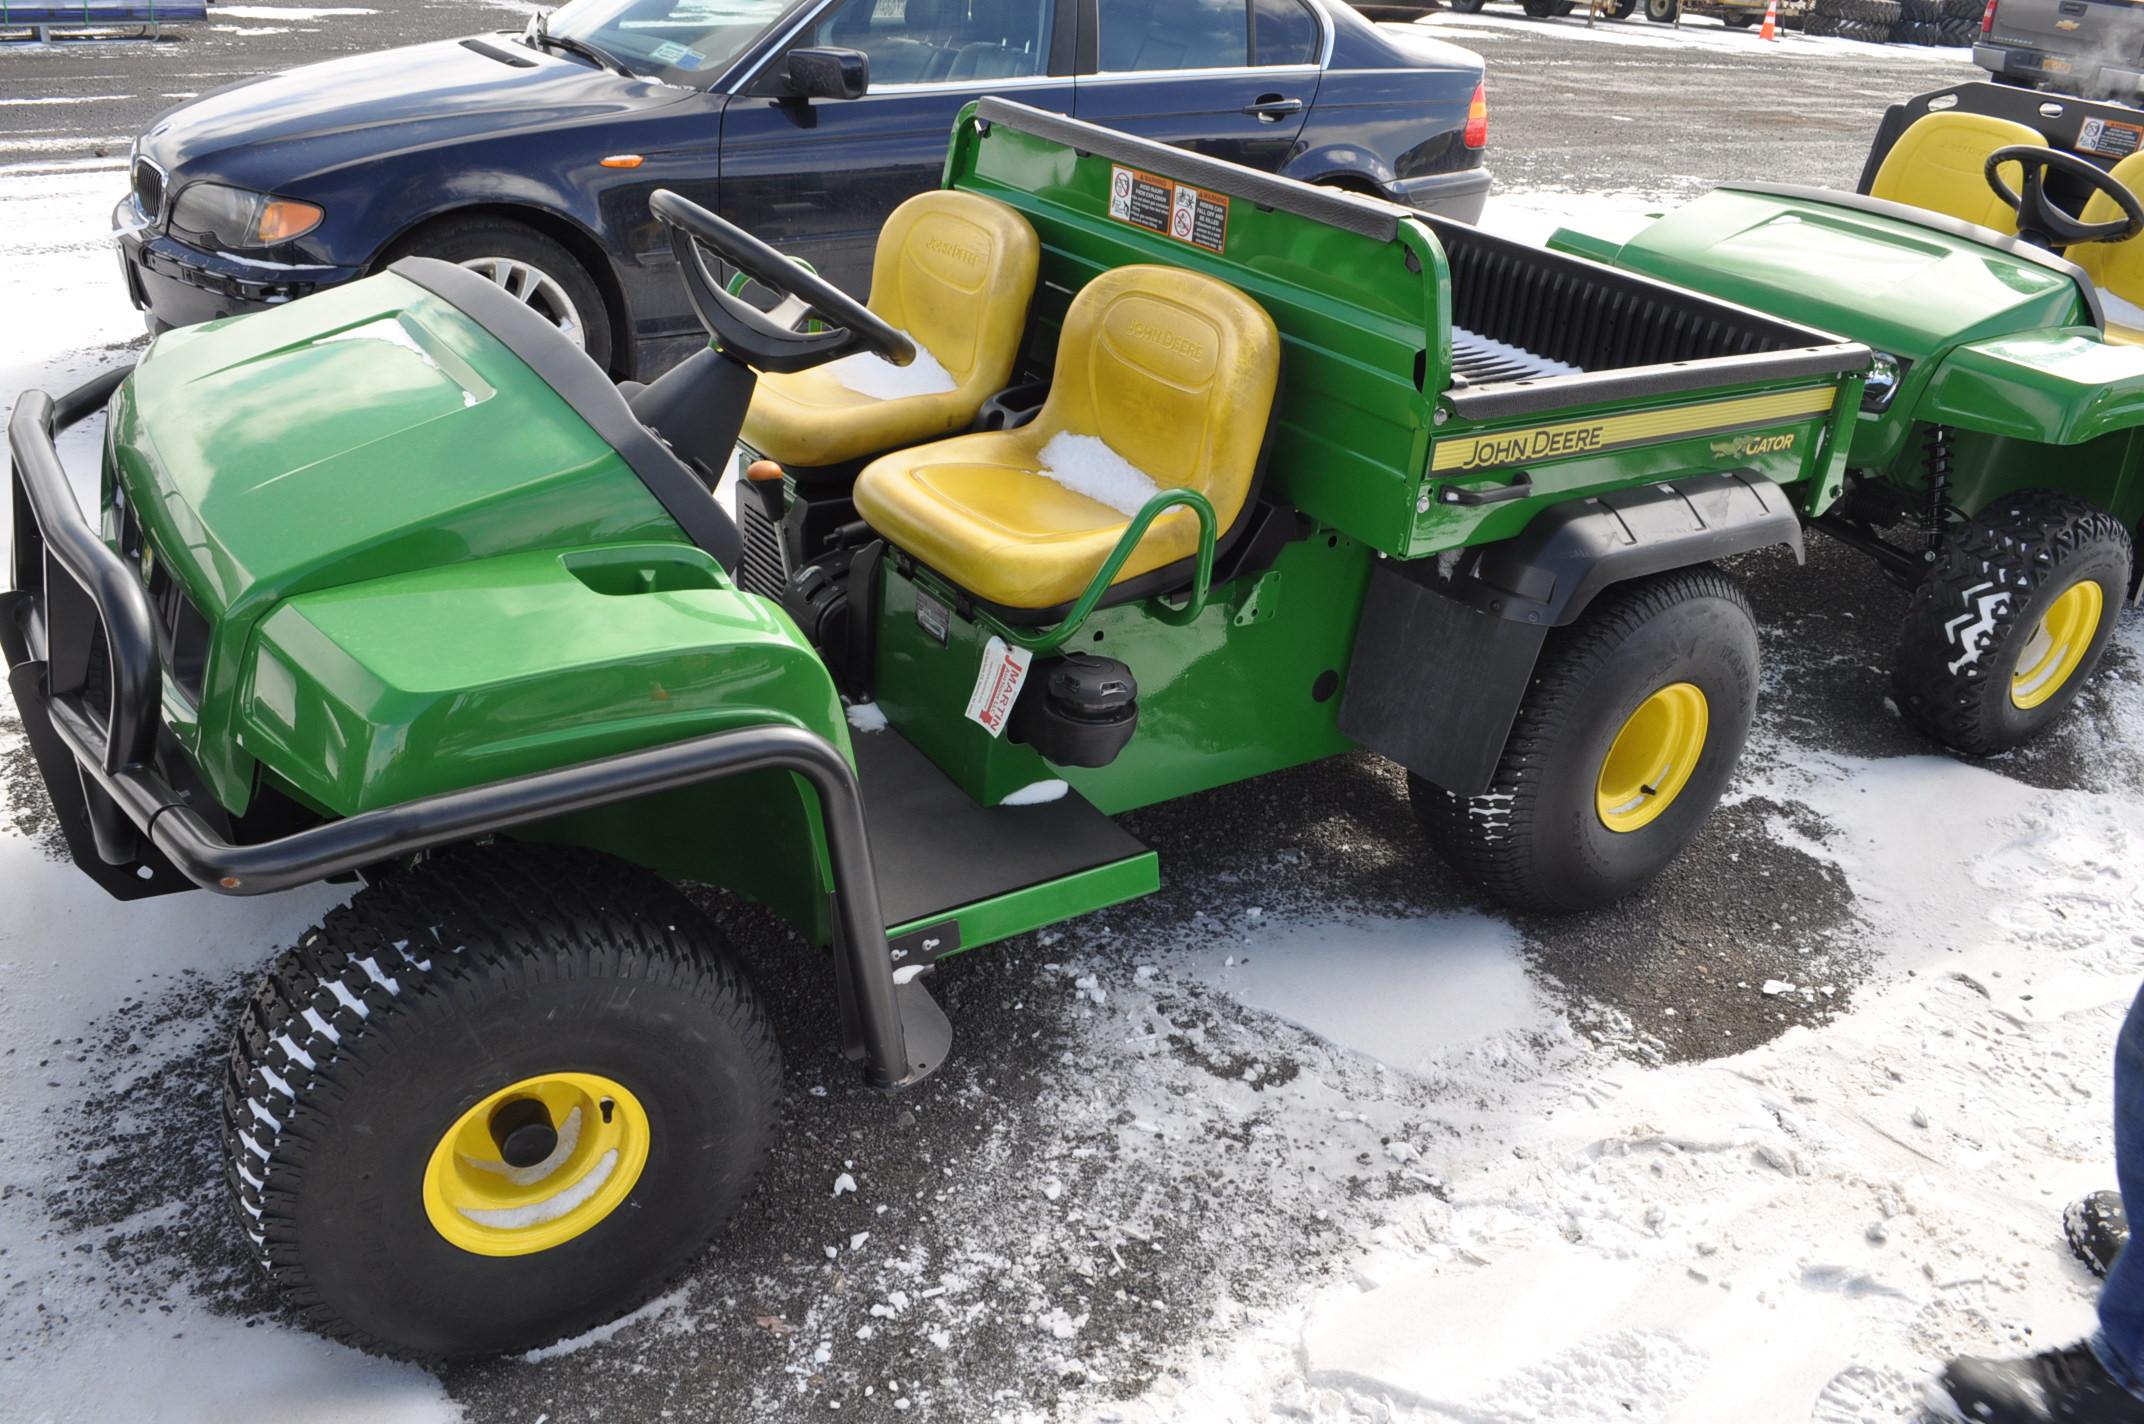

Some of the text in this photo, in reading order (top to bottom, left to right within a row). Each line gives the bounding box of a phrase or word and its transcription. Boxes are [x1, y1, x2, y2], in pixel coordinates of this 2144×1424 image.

[1127, 320, 1204, 360] JOHN DEERE
[1463, 426, 1604, 467] JOHN DEERE
[1745, 432, 1795, 455] GATOR
